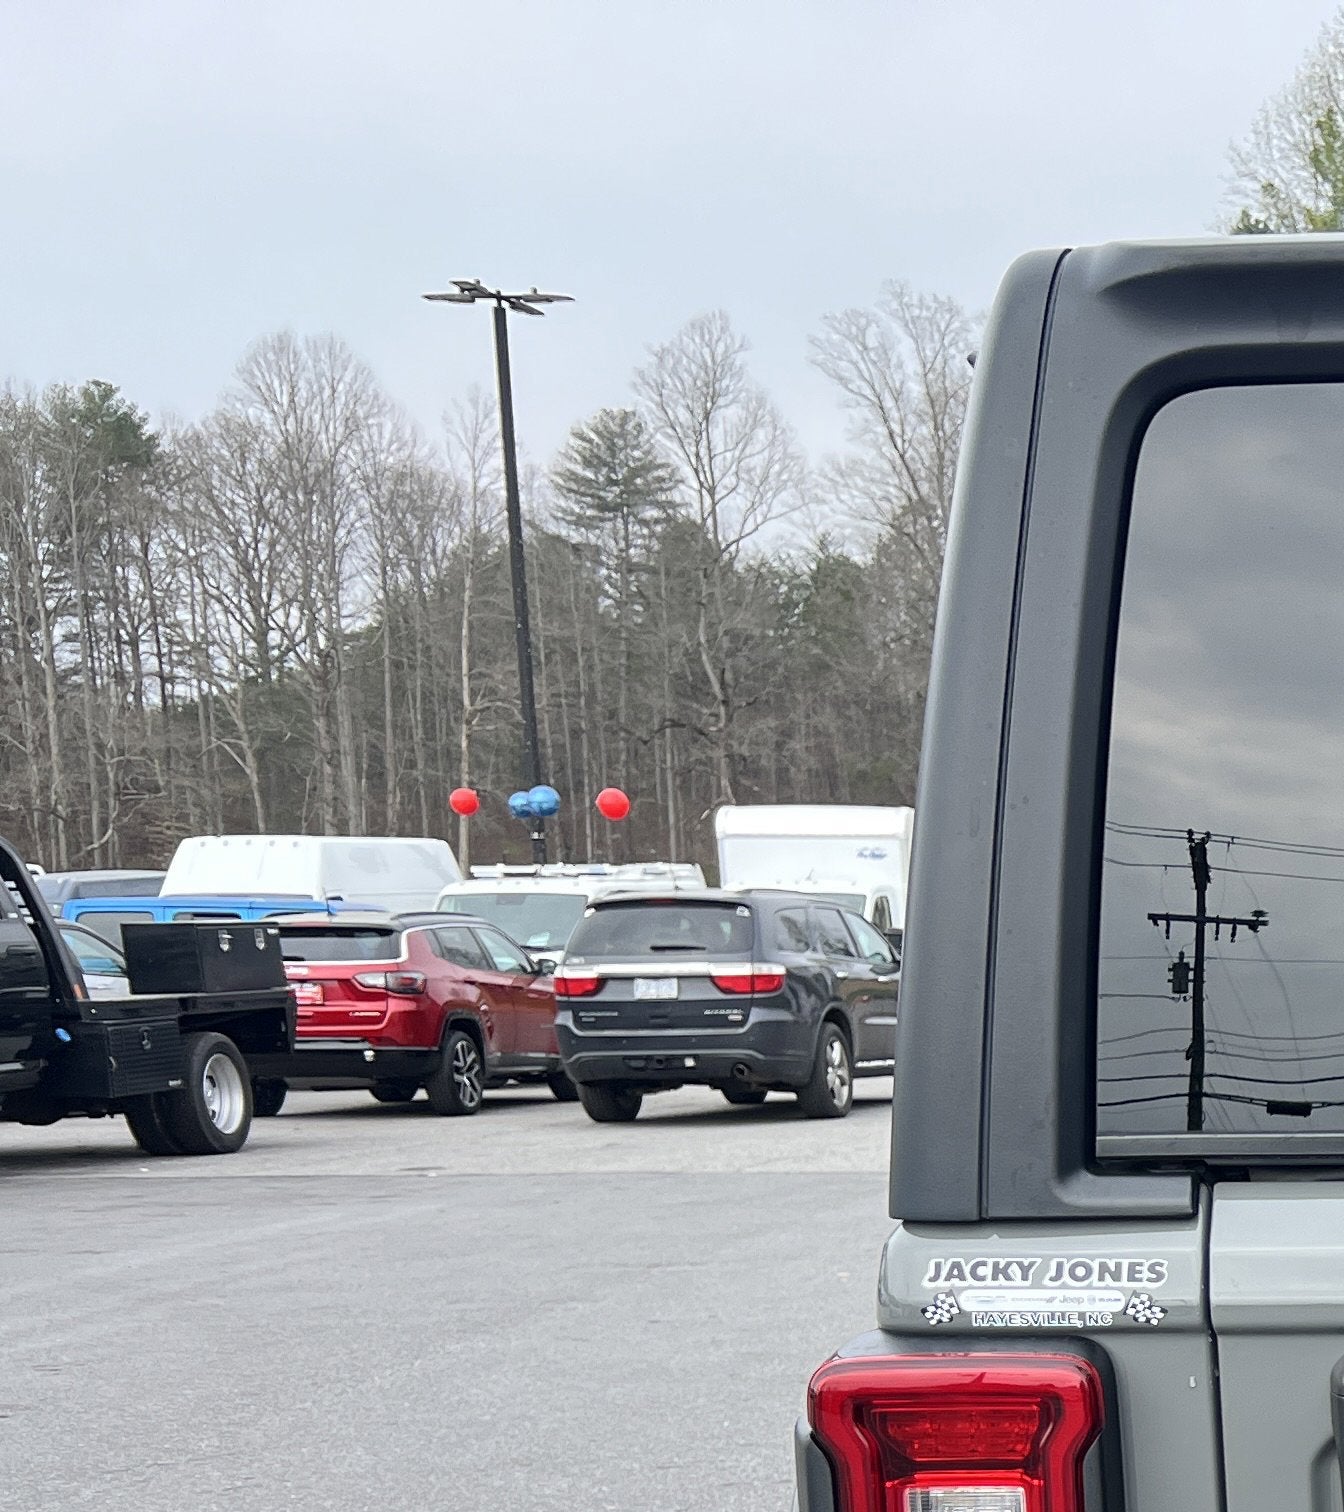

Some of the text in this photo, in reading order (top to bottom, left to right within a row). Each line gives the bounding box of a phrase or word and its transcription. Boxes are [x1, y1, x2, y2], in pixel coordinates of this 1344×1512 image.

[922, 1258, 1168, 1288] JACKY JONES
[972, 1312, 1113, 1328] HAYESVILLE, NC
